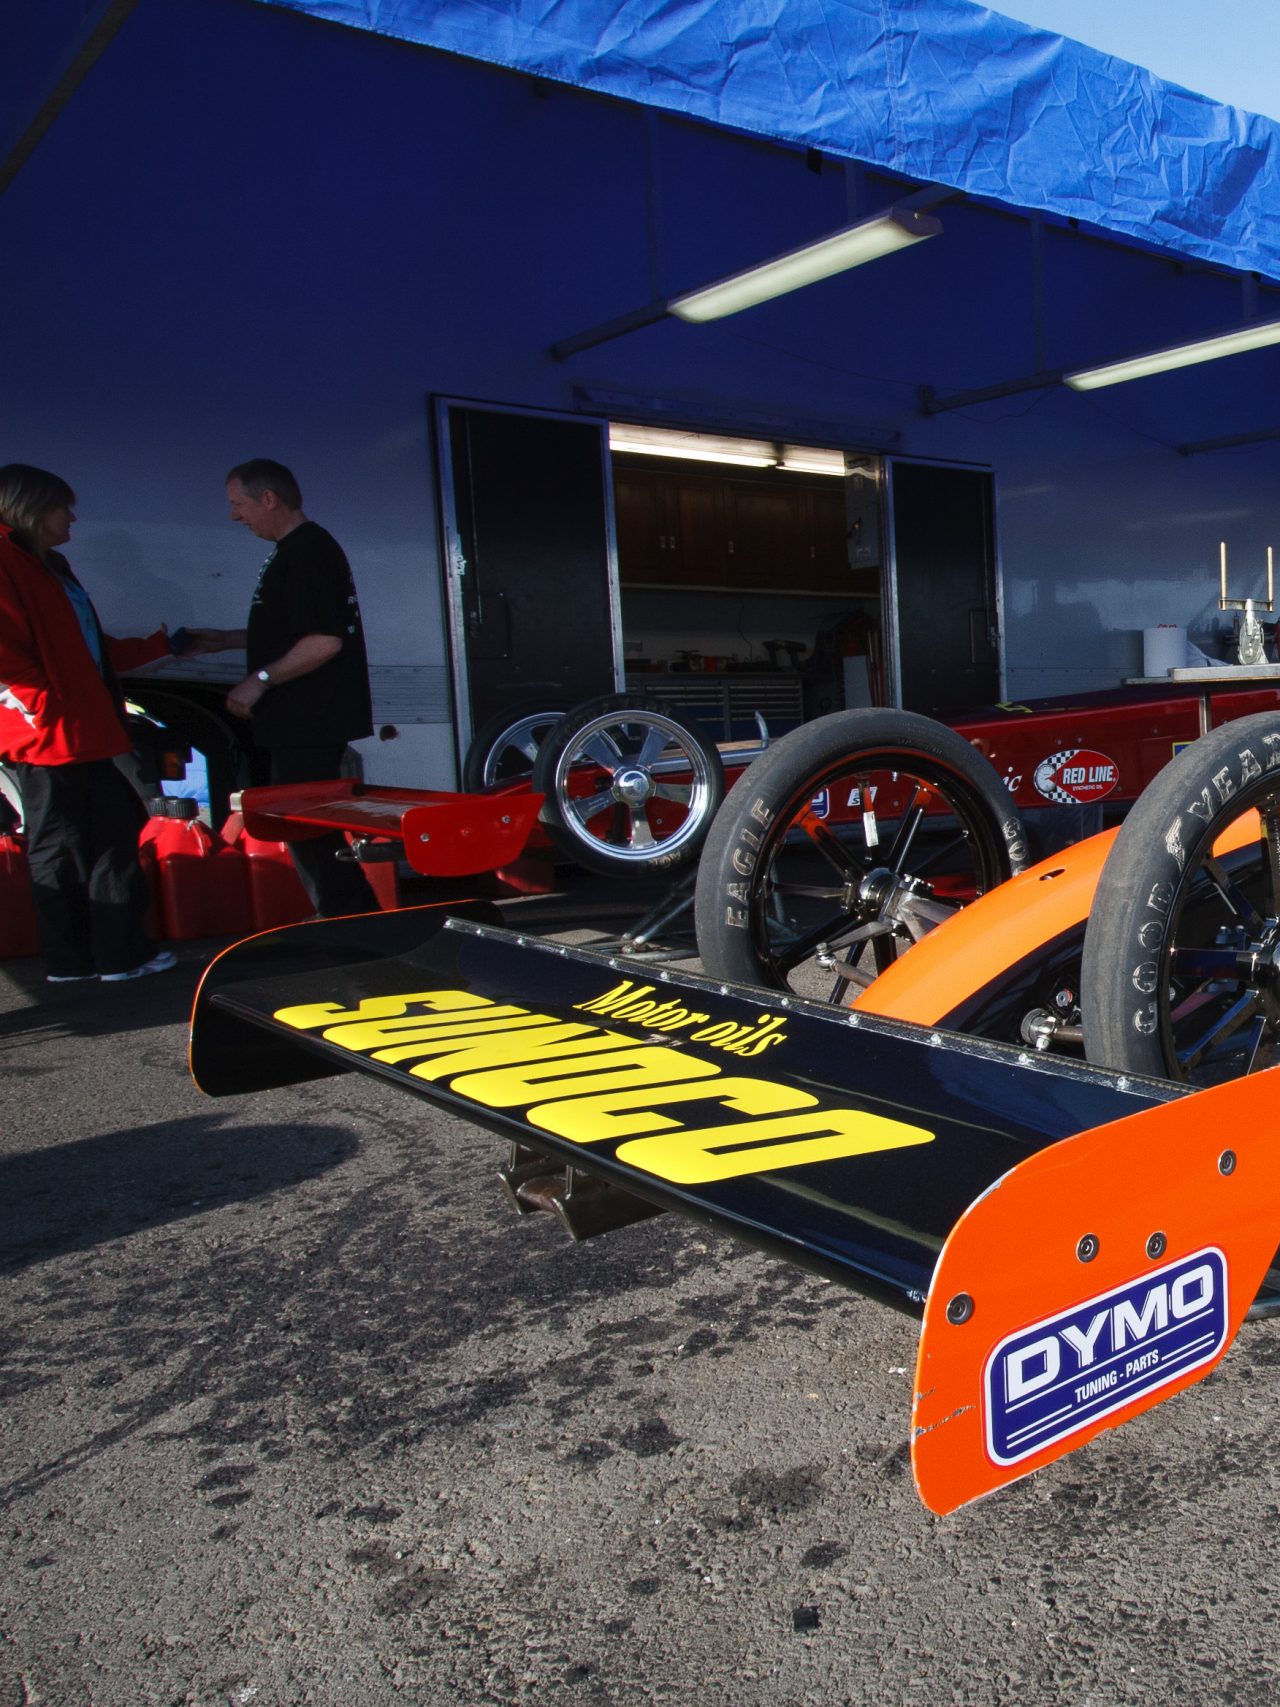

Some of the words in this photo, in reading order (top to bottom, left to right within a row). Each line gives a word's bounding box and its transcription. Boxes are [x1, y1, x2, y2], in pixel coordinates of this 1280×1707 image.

[1063, 767, 1085, 784] RED
[1088, 765, 1115, 783] LINE
[725, 798, 775, 928] EAGLE
[572, 980, 710, 1031] Motor
[690, 1014, 788, 1057] oils
[273, 990, 936, 1185] SUNOCO
[1003, 1264, 1214, 1405] DYMO
[1074, 1370, 1118, 1403] TUNING
[1125, 1349, 1160, 1379] PARTS
